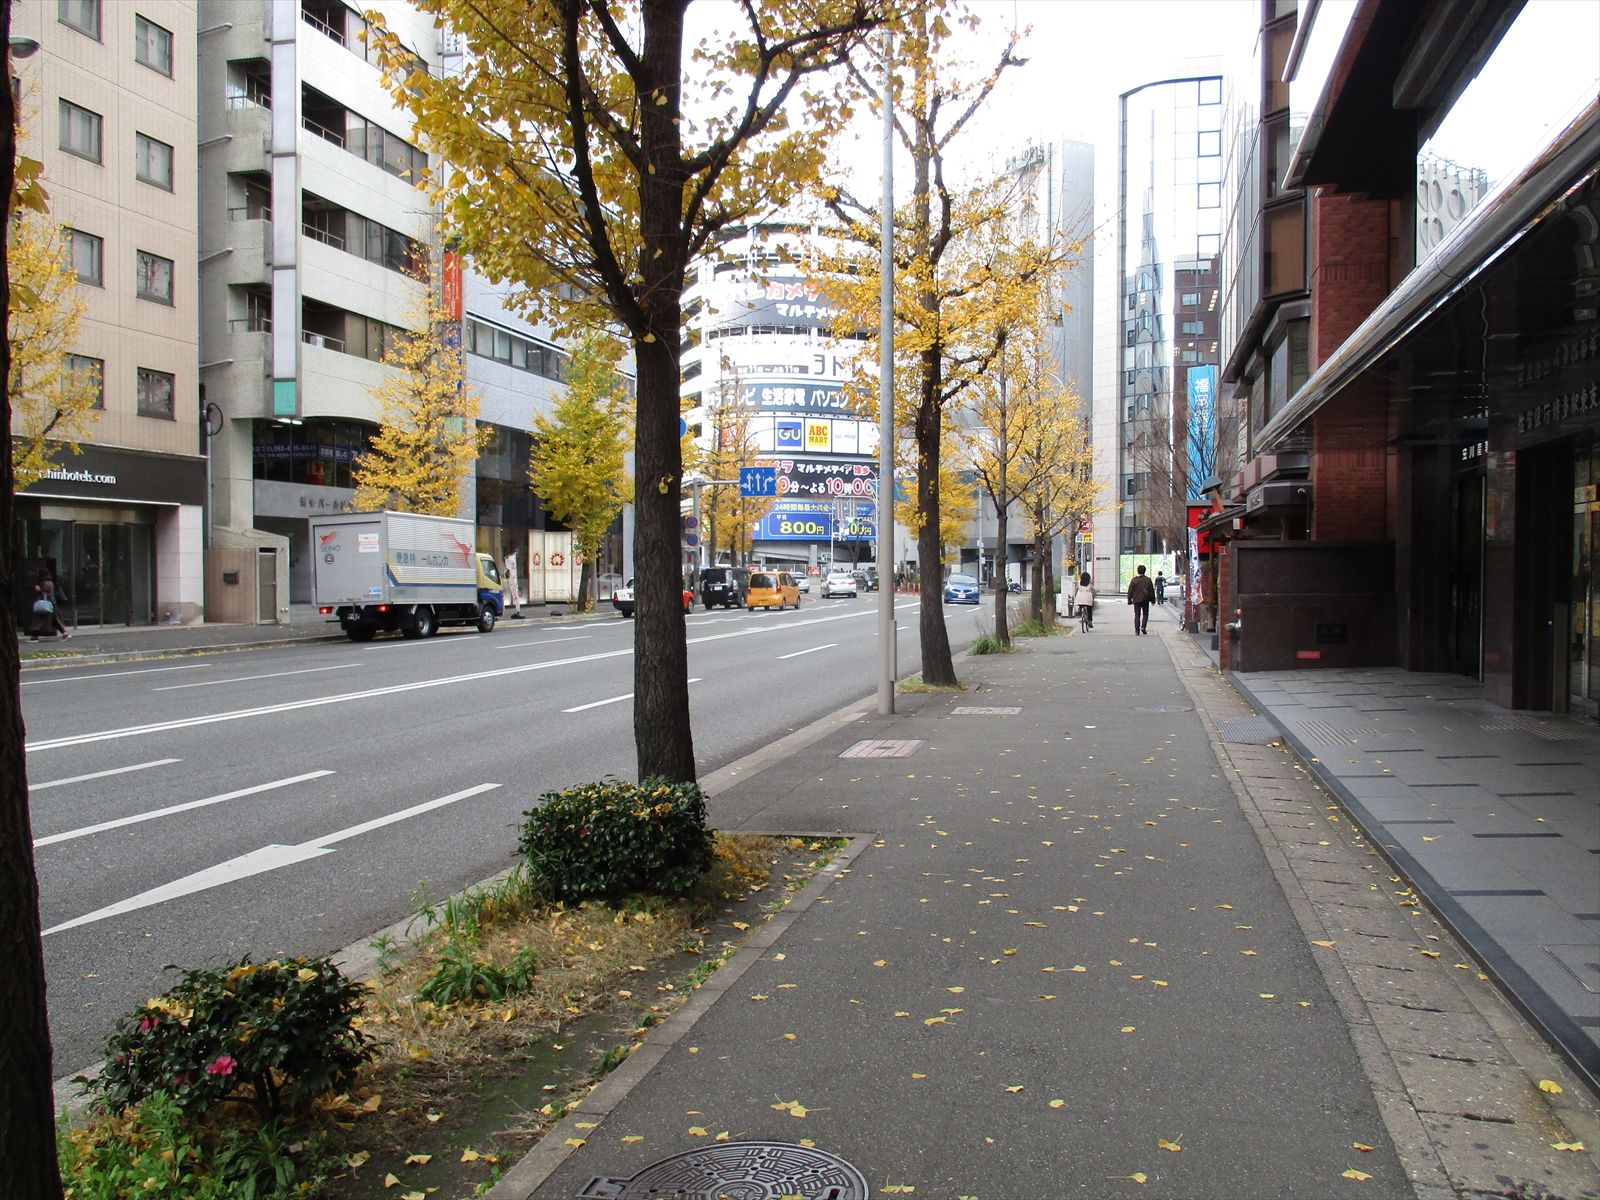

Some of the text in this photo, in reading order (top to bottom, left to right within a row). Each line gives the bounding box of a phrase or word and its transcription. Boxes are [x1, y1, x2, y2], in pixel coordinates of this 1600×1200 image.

[761, 387, 806, 407] 生活家電
[778, 428, 801, 441] GU
[808, 425, 828, 436] ABC
[808, 436, 828, 444] MART
[797, 463, 852, 475] マルチメディア
[853, 465, 871, 476] 博多
[780, 521, 825, 535] 800円
